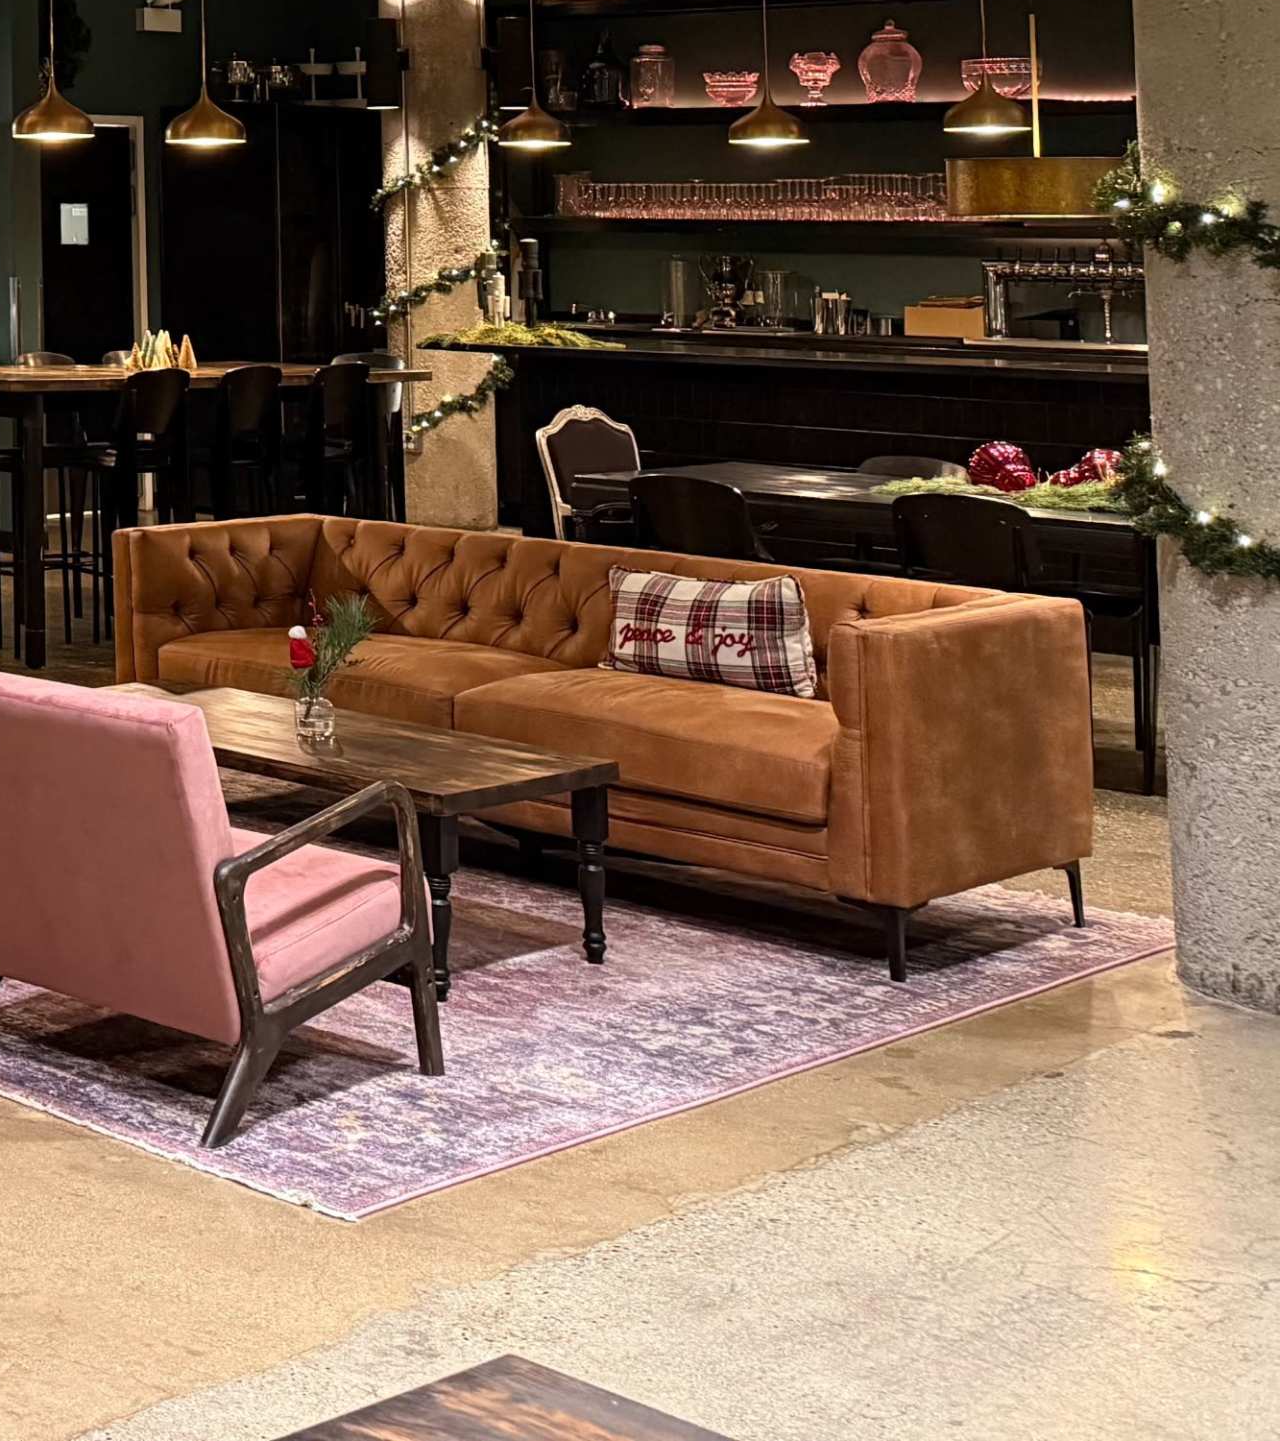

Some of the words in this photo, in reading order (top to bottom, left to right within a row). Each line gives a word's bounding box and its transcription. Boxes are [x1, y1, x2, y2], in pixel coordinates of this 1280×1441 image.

[619, 623, 676, 650] peace
[686, 621, 703, 645] &
[711, 626, 756, 658] joy
